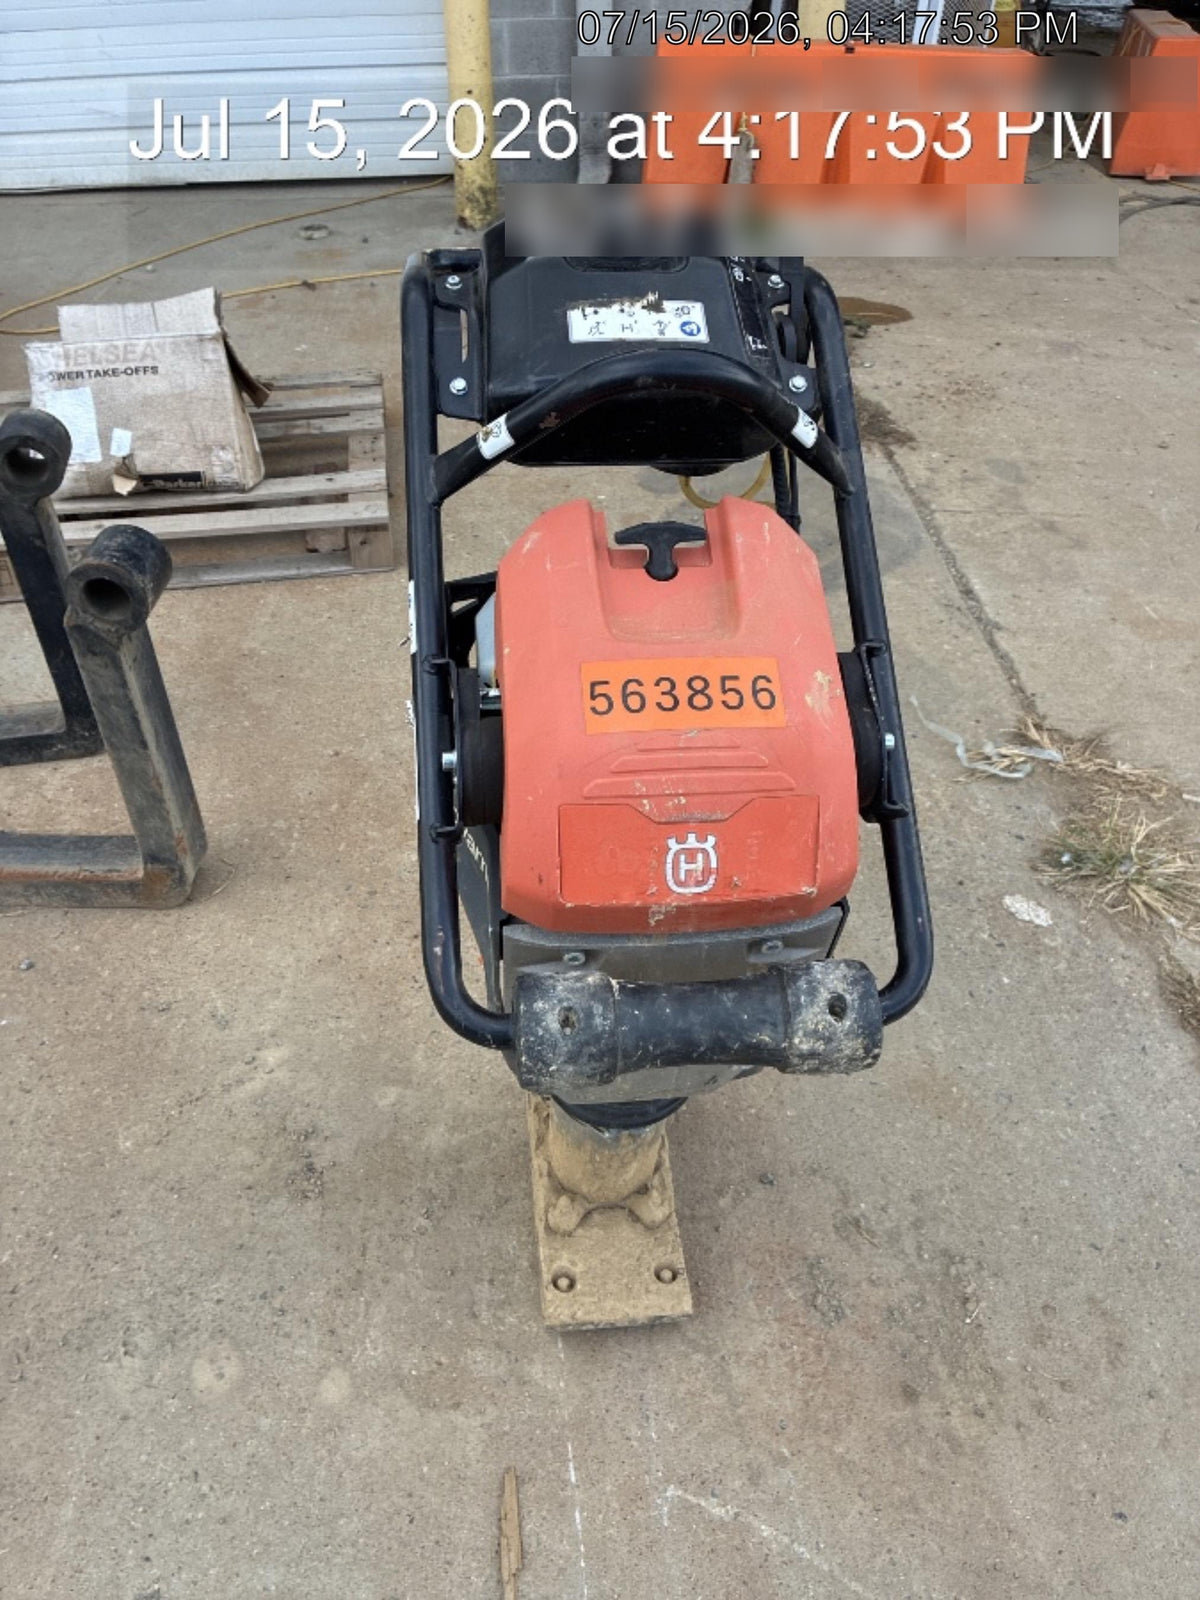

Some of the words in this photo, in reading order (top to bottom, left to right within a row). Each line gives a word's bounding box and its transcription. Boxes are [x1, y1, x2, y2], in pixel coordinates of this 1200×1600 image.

[47, 370, 85, 382] OWER
[86, 365, 160, 379] TAKE-OFFS
[588, 674, 777, 716] 563856
